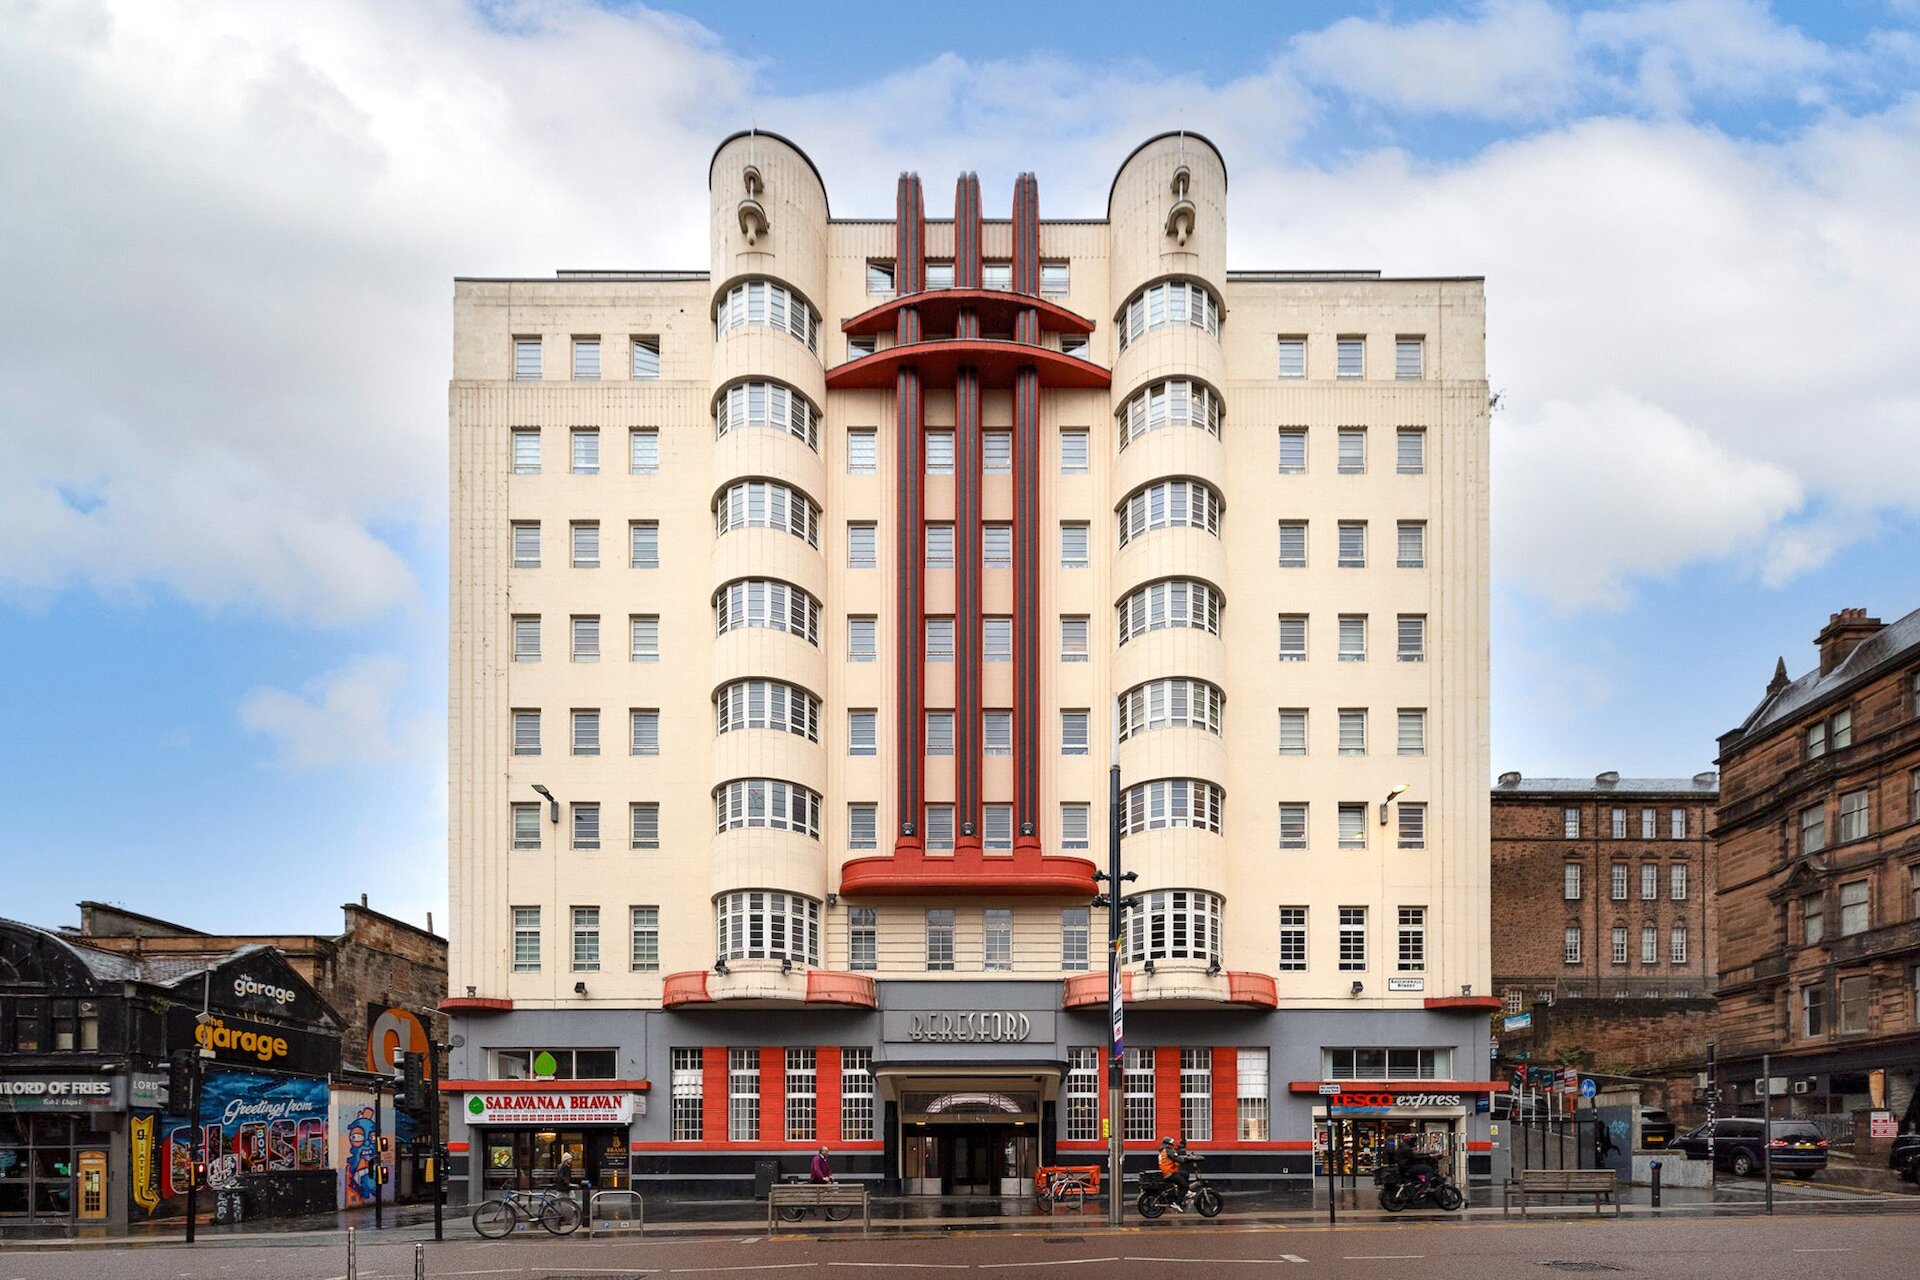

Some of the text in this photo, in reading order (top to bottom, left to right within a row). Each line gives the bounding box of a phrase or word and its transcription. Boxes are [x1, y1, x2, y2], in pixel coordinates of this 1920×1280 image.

[240, 973, 252, 981] the
[234, 979, 295, 1005] garage
[908, 1011, 1030, 1041] BERESFORD
[195, 1023, 288, 1061] garage
[48, 1081, 71, 1095] OF
[72, 1081, 111, 1095] FRIES
[133, 1080, 158, 1090] LORD
[486, 1095, 566, 1110] SARAVANAA
[570, 1095, 622, 1110] BHAVAN
[1331, 1093, 1393, 1107] TESCO
[1396, 1092, 1461, 1109] express
[222, 1099, 313, 1125] Greetings from
[256, 1129, 266, 1158] BOX
